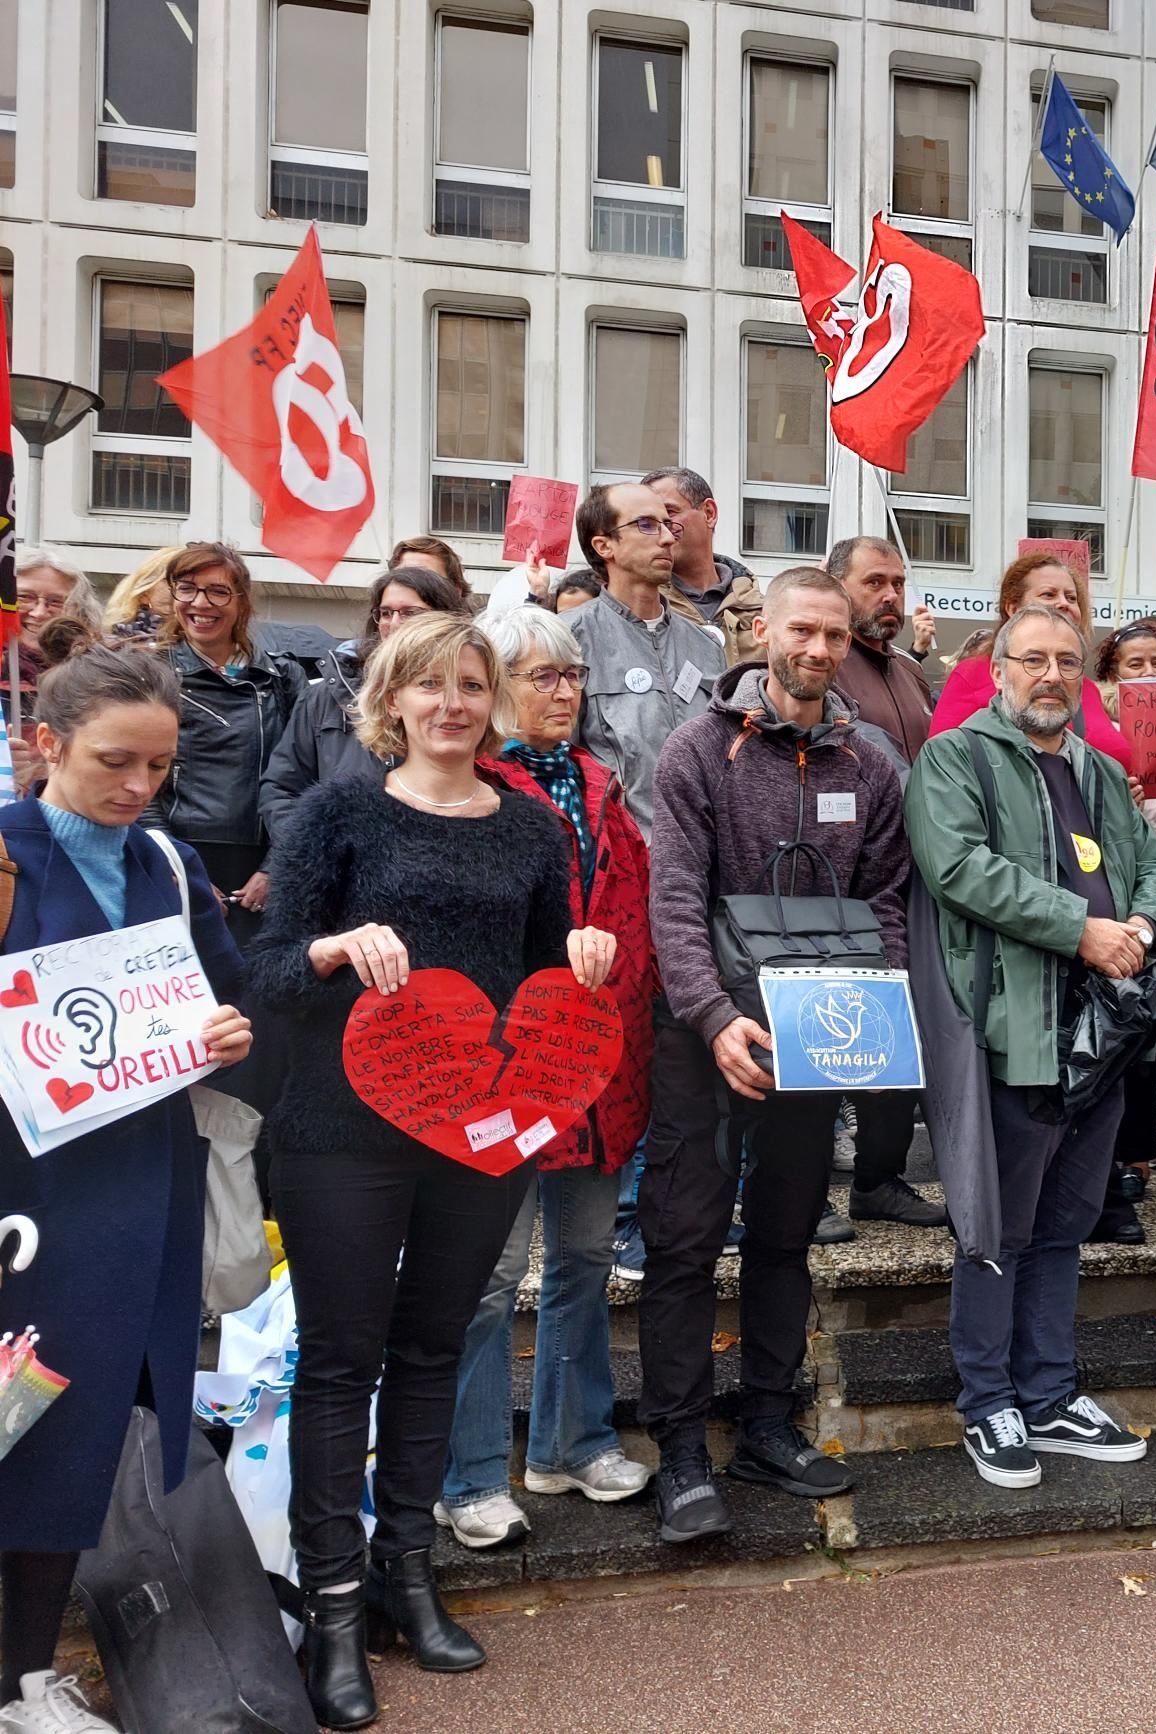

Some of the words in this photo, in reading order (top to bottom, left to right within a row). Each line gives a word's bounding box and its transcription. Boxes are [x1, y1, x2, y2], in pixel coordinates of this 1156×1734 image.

[119, 973, 206, 1014] OUVRE
[525, 985, 574, 1001] HONTE
[147, 1016, 180, 1039] tes
[350, 1013, 447, 1056] L'OMERTA
[455, 1002, 490, 1023] SUR
[353, 1002, 406, 1033] STOP
[521, 1005, 548, 1021] PAS
[552, 1010, 570, 1025] DE
[573, 1014, 622, 1039] RESPECT
[351, 1060, 376, 1077] LE
[380, 1034, 456, 1067] NOMBRE
[515, 1026, 543, 1042] DES
[548, 1031, 573, 1050] LOIS
[576, 1041, 600, 1056] SUR
[360, 1051, 457, 1097] D'ENFANTS
[463, 1040, 484, 1056] EN
[467, 1055, 492, 1072] DE
[812, 1053, 887, 1068] TANAGILA
[515, 1065, 534, 1079] DU
[538, 1071, 577, 1089] DROIT
[392, 1077, 474, 1122] HANDICAP
[406, 1111, 446, 1135] SANS
